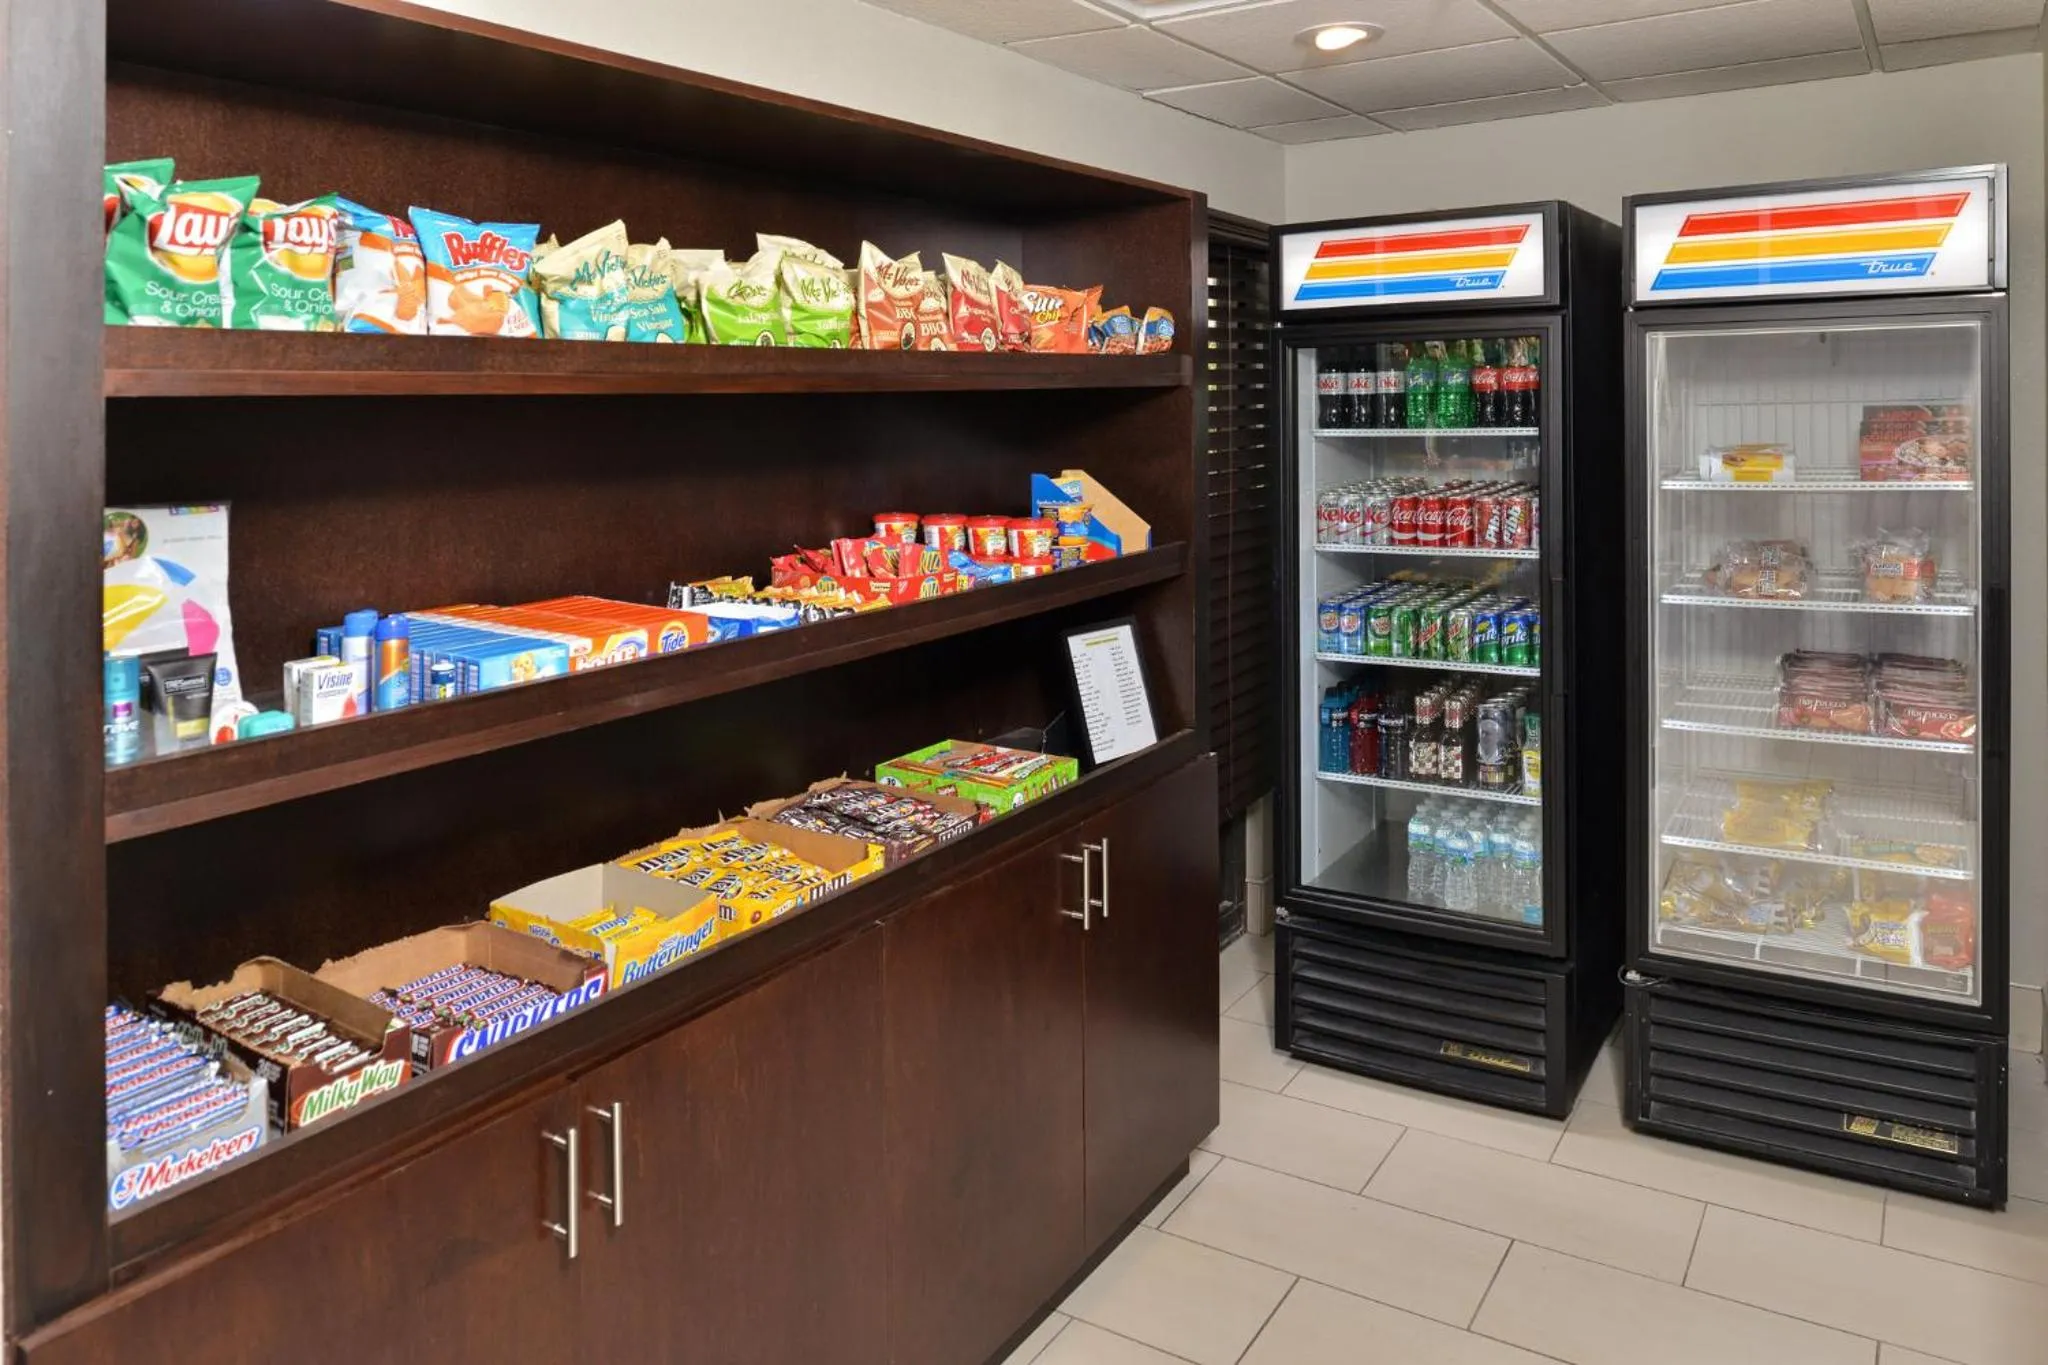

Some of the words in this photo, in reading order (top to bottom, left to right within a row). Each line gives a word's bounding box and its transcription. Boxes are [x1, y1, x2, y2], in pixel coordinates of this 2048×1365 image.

[442, 231, 532, 272] Ruffles
[145, 281, 188, 300] Sour
[270, 283, 310, 300] Sour
[160, 301, 172, 313] &
[175, 303, 221, 318] Onion
[661, 632, 686, 653] Tide
[318, 671, 354, 690] Visine
[621, 917, 716, 985] Butterfinger
[451, 978, 521, 1015] SNICKERS
[475, 983, 544, 1018] SNICKERS
[301, 1076, 360, 1126] Milky
[359, 1060, 405, 1095] Way
[117, 1167, 138, 1201] 3
[138, 1128, 260, 1198] Musketeers
